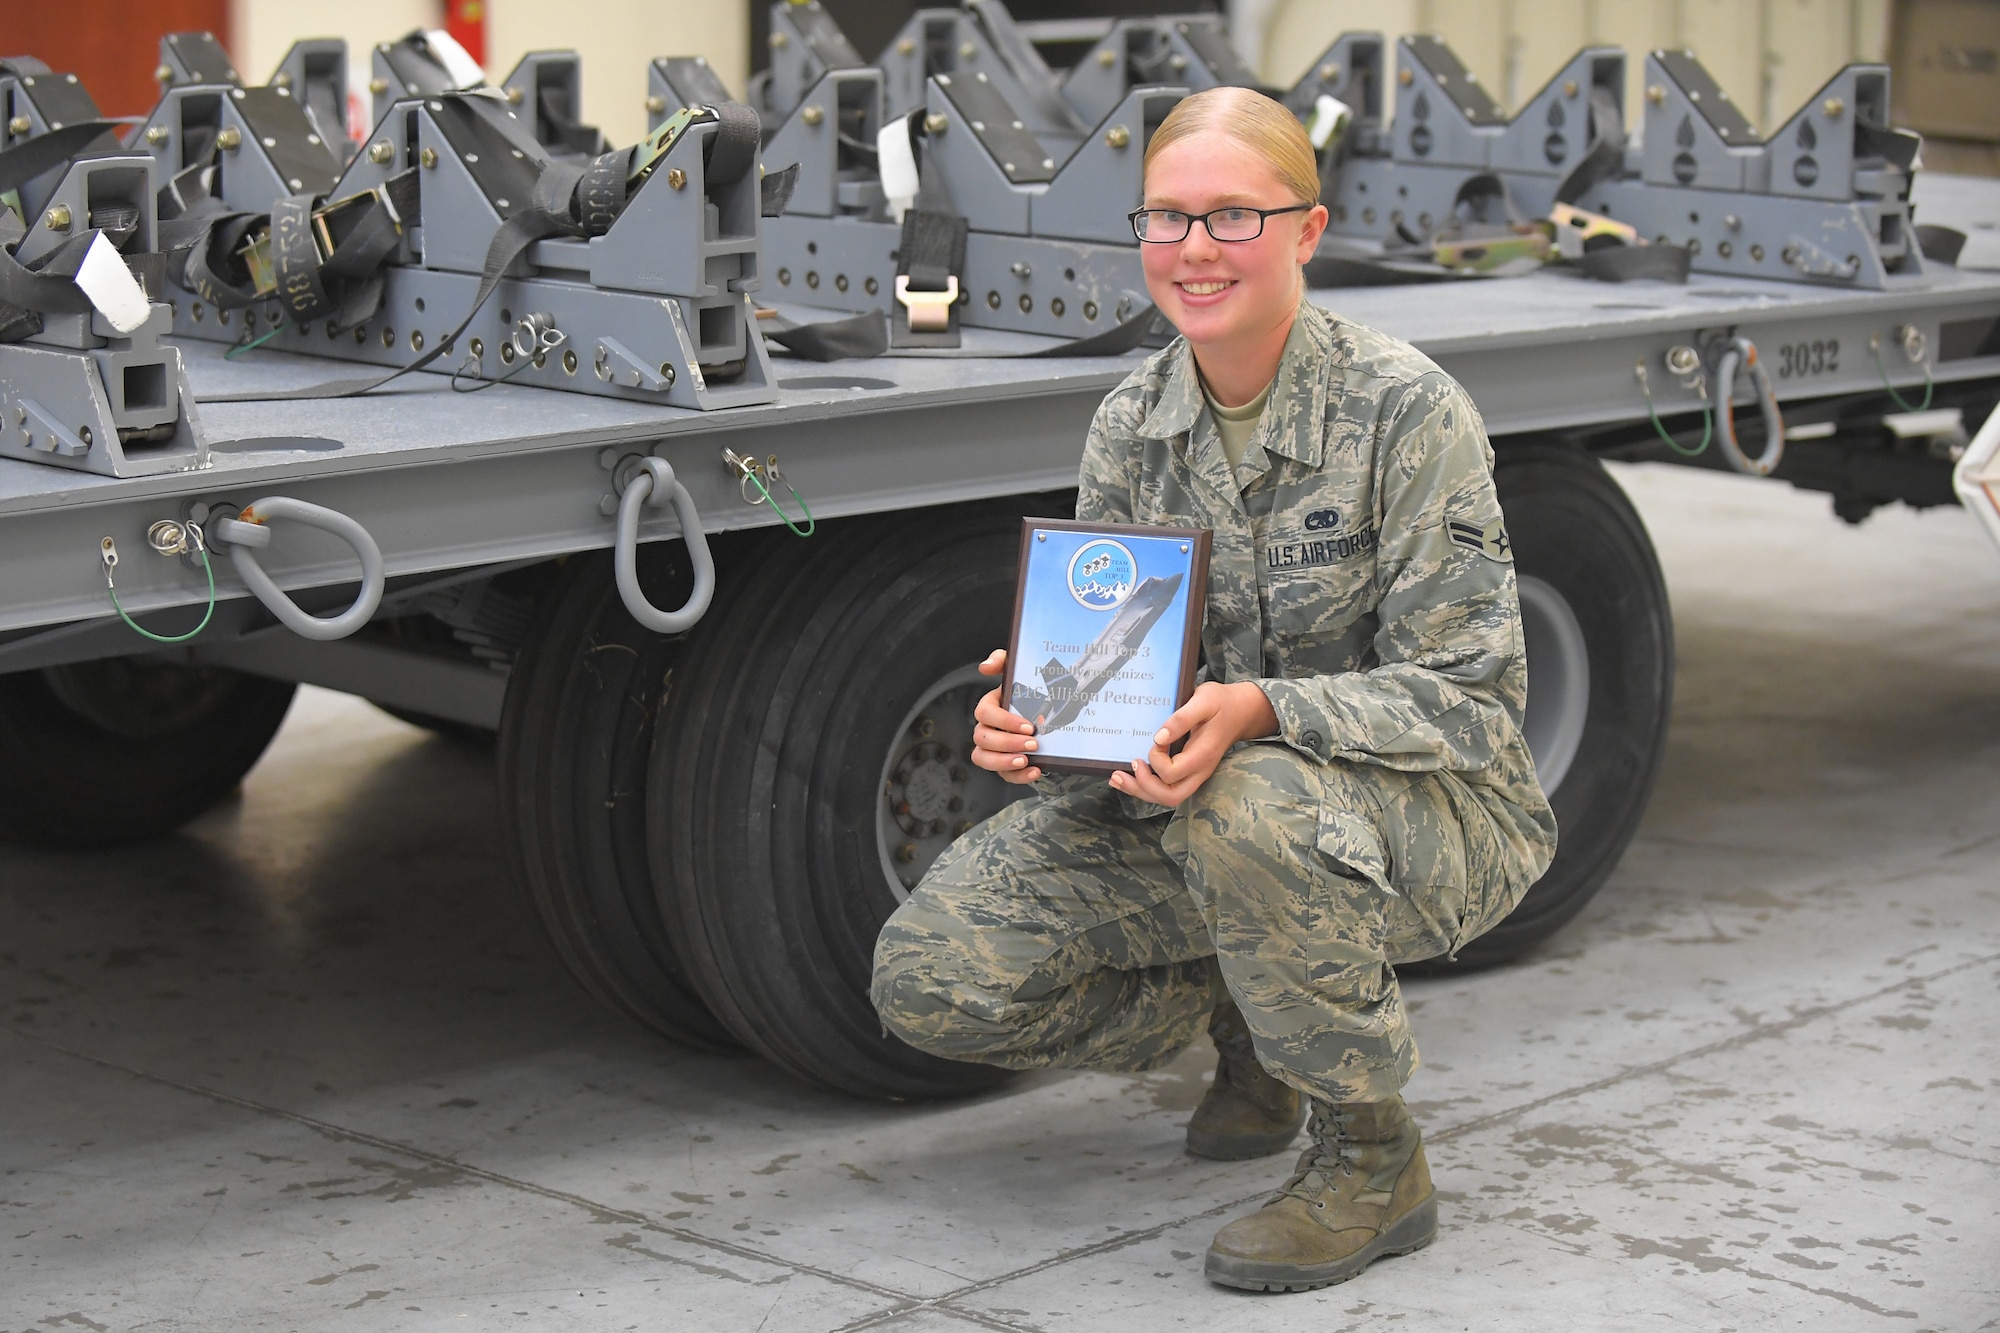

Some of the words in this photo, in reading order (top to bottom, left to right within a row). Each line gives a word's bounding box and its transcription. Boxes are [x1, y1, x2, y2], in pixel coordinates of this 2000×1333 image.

[1779, 339, 1840, 379] 3032
[1268, 545, 1297, 568] U.S.
[1301, 541, 1325, 565] AIR
[1324, 524, 1378, 562] FORCE
[1043, 640, 1080, 654] Team
[1085, 642, 1109, 655] Hill
[1112, 643, 1138, 660] Top
[1142, 646, 1151, 658] 3
[1034, 664, 1085, 679] proudly
[1087, 668, 1154, 681] recognizes
[1044, 686, 1099, 702] Allison
[1104, 690, 1171, 706] Petersen
[1084, 708, 1096, 716] As
[1077, 725, 1124, 735] Performer
[1132, 729, 1153, 737] June
